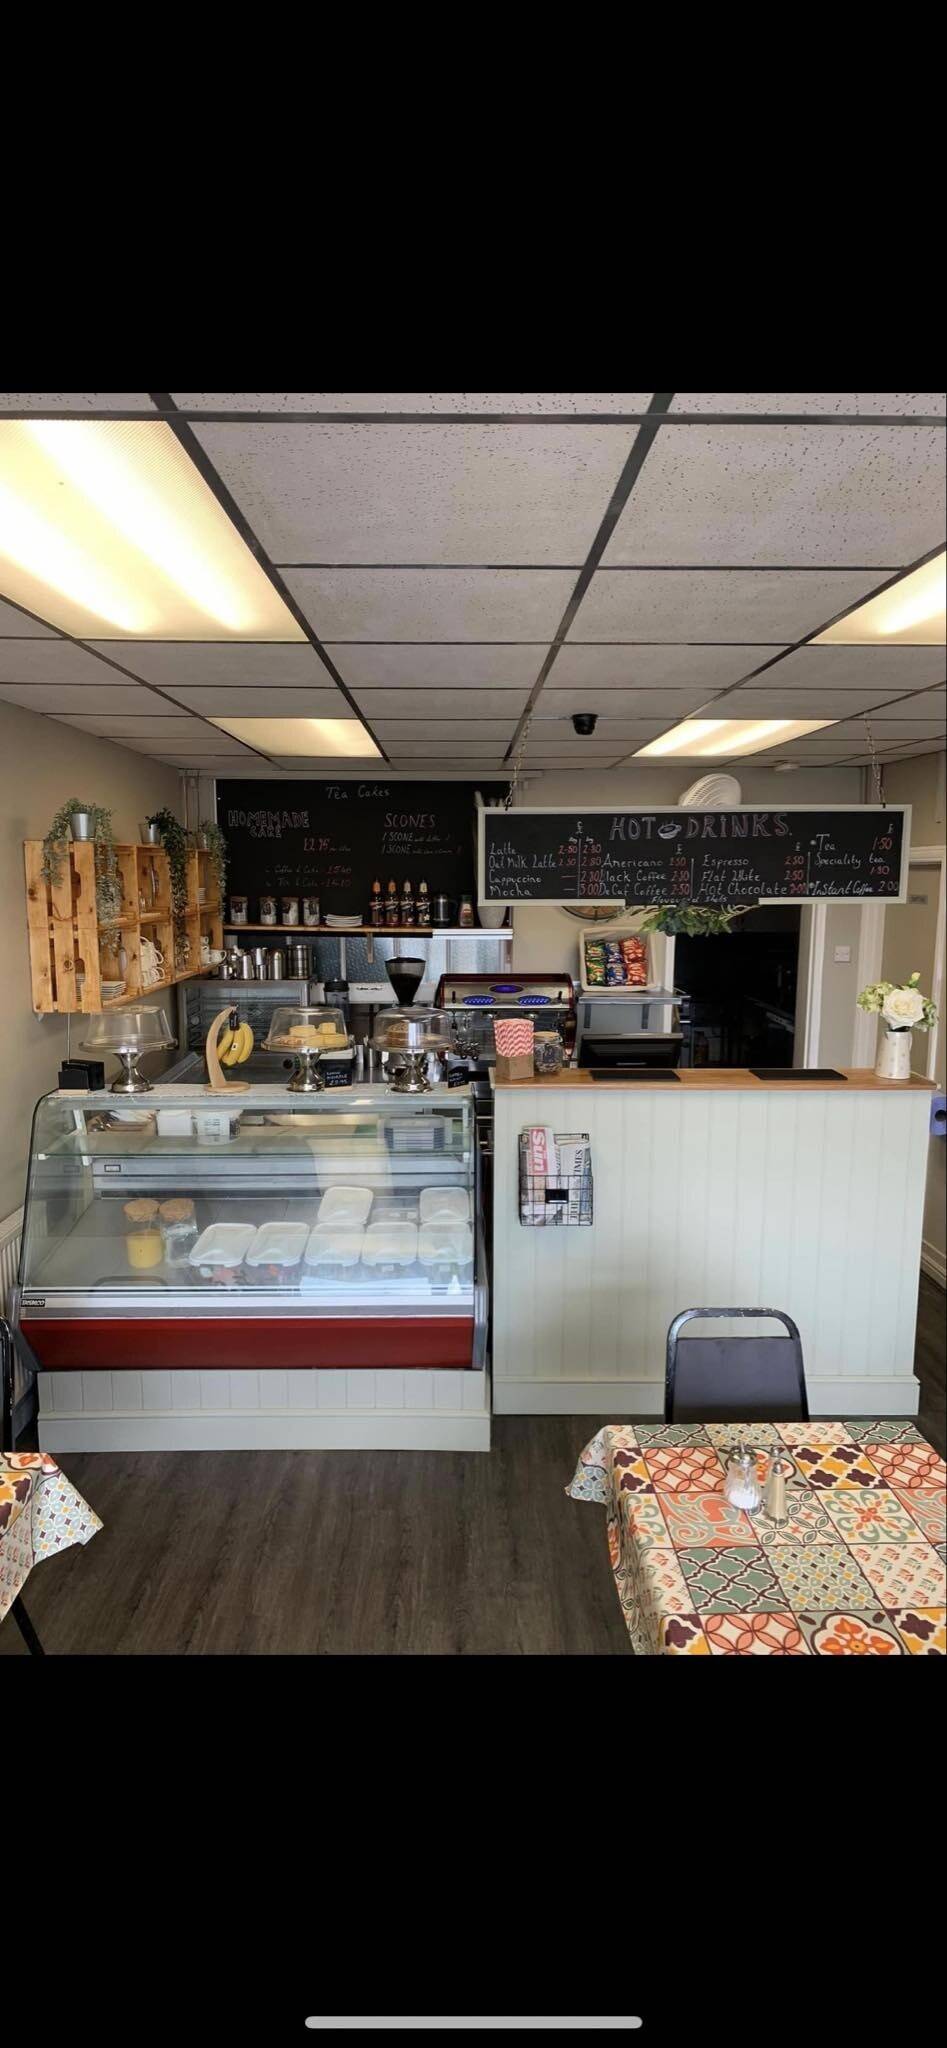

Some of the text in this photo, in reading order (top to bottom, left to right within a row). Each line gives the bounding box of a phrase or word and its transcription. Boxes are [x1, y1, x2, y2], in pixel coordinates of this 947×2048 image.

[325, 785, 391, 800] Tea Cakes
[227, 810, 310, 829] HOMEMADE
[383, 813, 436, 829] SCONES
[609, 816, 656, 840] HOT
[388, 832, 413, 842] SCONE
[816, 833, 836, 851] Tea
[489, 842, 516, 856] Latte
[532, 854, 558, 868] Latte
[601, 853, 663, 868] Americano
[702, 854, 749, 869] Espresso
[815, 851, 886, 870] Speciality tea
[489, 869, 542, 886] Cappuccino
[636, 870, 667, 882] Coffee
[701, 870, 727, 882] Flat
[731, 868, 760, 882] White
[489, 883, 534, 897] Mocha
[634, 883, 669, 896] Coffee
[699, 882, 723, 896] Hot
[727, 882, 788, 896] Chocolate
